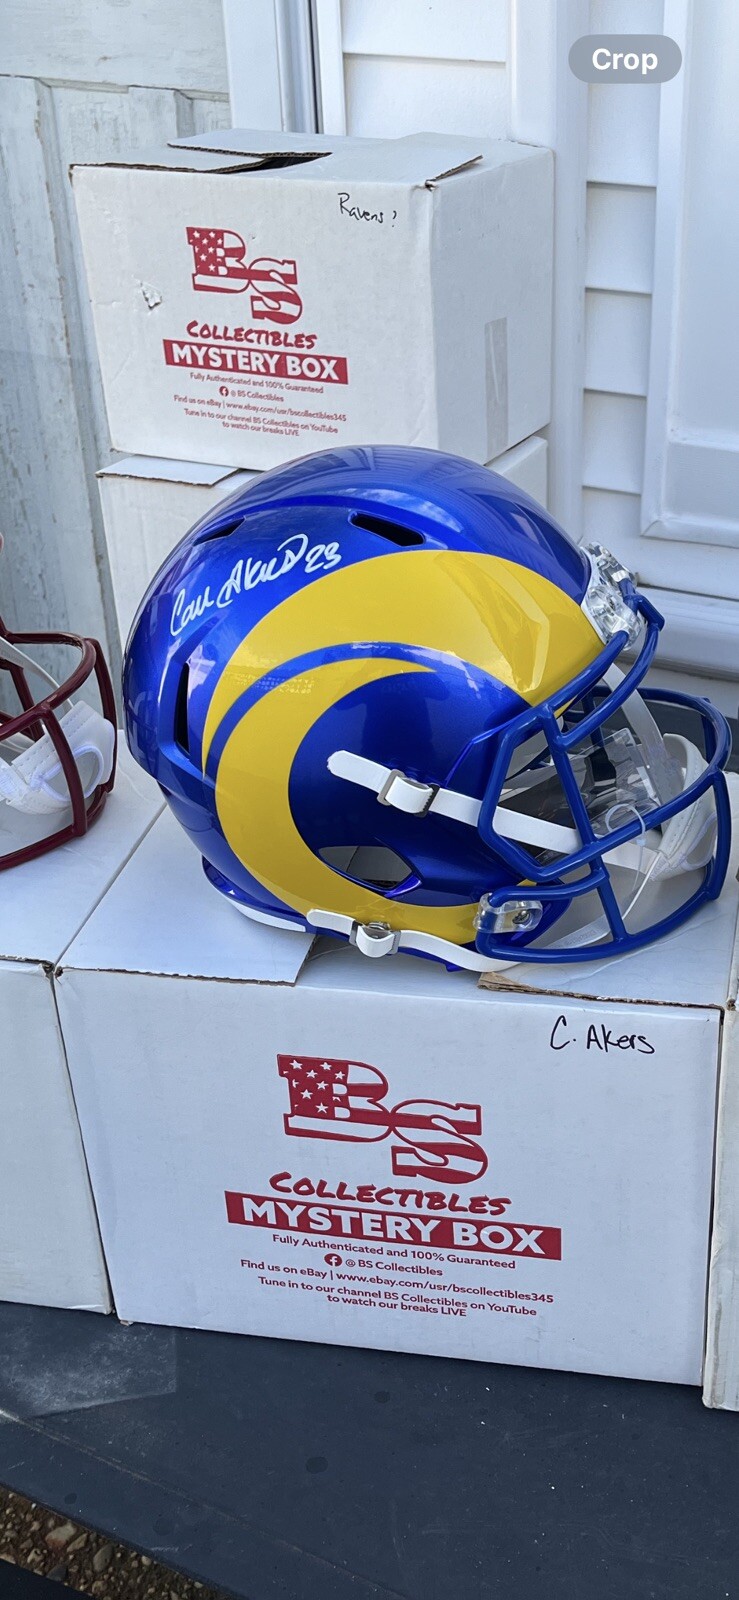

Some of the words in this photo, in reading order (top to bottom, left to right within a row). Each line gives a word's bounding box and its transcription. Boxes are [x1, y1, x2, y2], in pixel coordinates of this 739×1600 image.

[186, 226, 302, 324] BS
[186, 320, 318, 350] COLLECTIBLES
[172, 344, 280, 374] MYSTERY
[286, 356, 339, 380] BOX
[190, 372, 204, 382] Fully
[206, 374, 251, 386] Authenticated
[265, 380, 284, 390] 100%
[285, 383, 324, 394] Guaranteed
[238, 390, 246, 398] BS
[246, 391, 284, 402] Collectibles
[174, 394, 188, 402] Find
[206, 399, 222, 408] eBay
[184, 408, 200, 416] Tune
[228, 414, 252, 422] channel
[262, 418, 300, 428] Collectibles
[310, 424, 338, 434] YouTube
[262, 426, 284, 434] breaks
[284, 428, 300, 436] LIVE
[586, 1024, 655, 1054] Akers
[276, 1054, 488, 1184] BS
[269, 1172, 512, 1216] COLLECTIBLES
[242, 1197, 440, 1243] MYSTERY
[452, 1222, 546, 1254] BOX
[272, 1234, 299, 1246] Fully
[302, 1238, 384, 1255] Authenticated
[386, 1250, 408, 1258] and
[411, 1250, 444, 1262] 100%
[447, 1254, 516, 1268] Guaranteed
[240, 1260, 264, 1270] Find
[283, 1266, 298, 1274] on
[300, 1268, 327, 1279] eBay
[336, 1272, 554, 1303] www.ebay.com/usr/bscollectibles345
[358, 1260, 373, 1268] BS
[375, 1262, 443, 1276] Collectibles
[258, 1276, 286, 1287] Tune
[288, 1280, 298, 1288] in
[301, 1282, 313, 1290] to
[337, 1287, 382, 1299] channel
[384, 1292, 399, 1300] BS
[401, 1293, 468, 1308] Collectibles
[487, 1302, 537, 1316] YouTube
[327, 1294, 340, 1303] to
[342, 1298, 376, 1307] watch
[400, 1302, 438, 1313] breaks
[441, 1308, 467, 1316] LIVE
